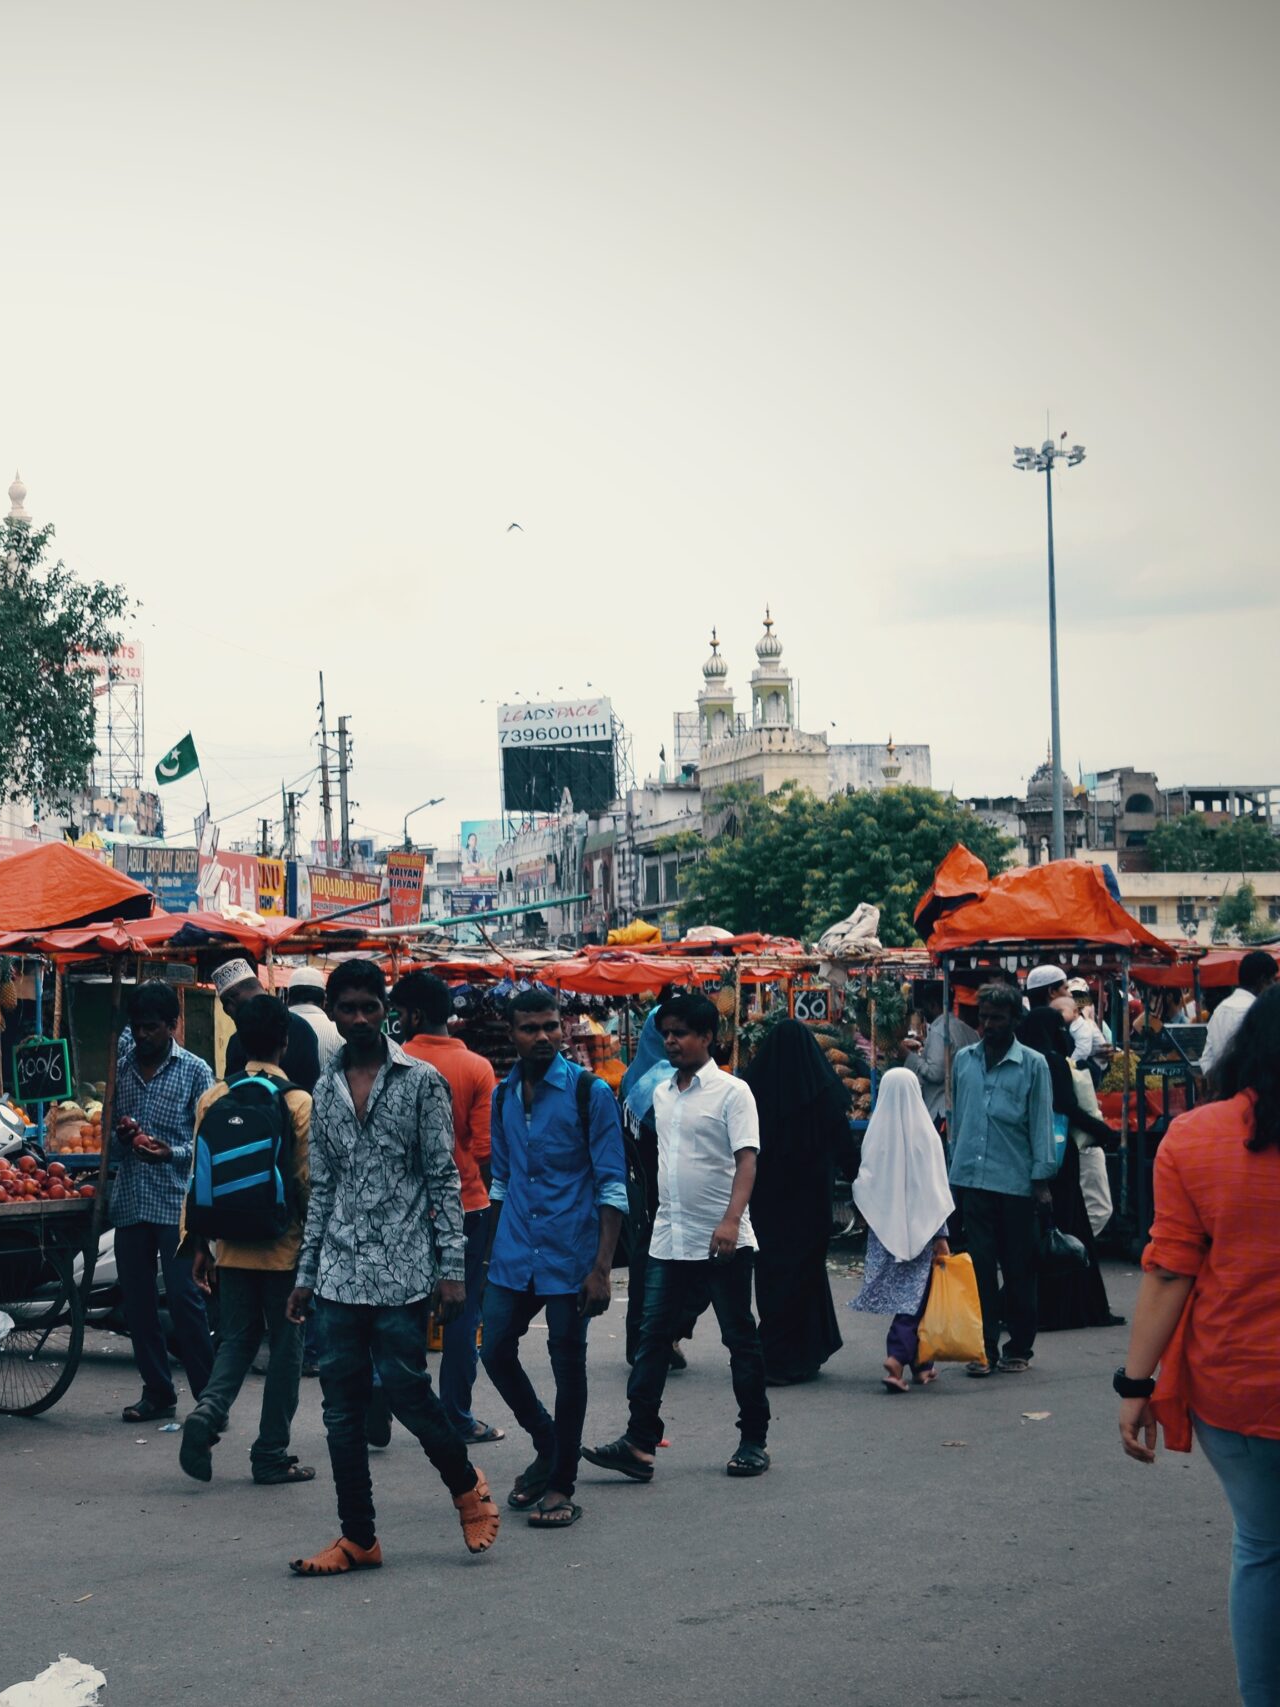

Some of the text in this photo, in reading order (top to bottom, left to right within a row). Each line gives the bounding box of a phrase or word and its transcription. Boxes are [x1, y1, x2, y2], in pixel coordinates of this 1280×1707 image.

[503, 704, 600, 723] LEADSPACE
[499, 723, 607, 744] 7396001111
[128, 849, 145, 871] ABUL
[175, 852, 199, 873] BAKERY
[311, 865, 355, 890] MUQADDAR
[356, 872, 378, 892] HOTEL
[389, 867, 422, 879] KALYANI
[795, 991, 826, 1019] 60
